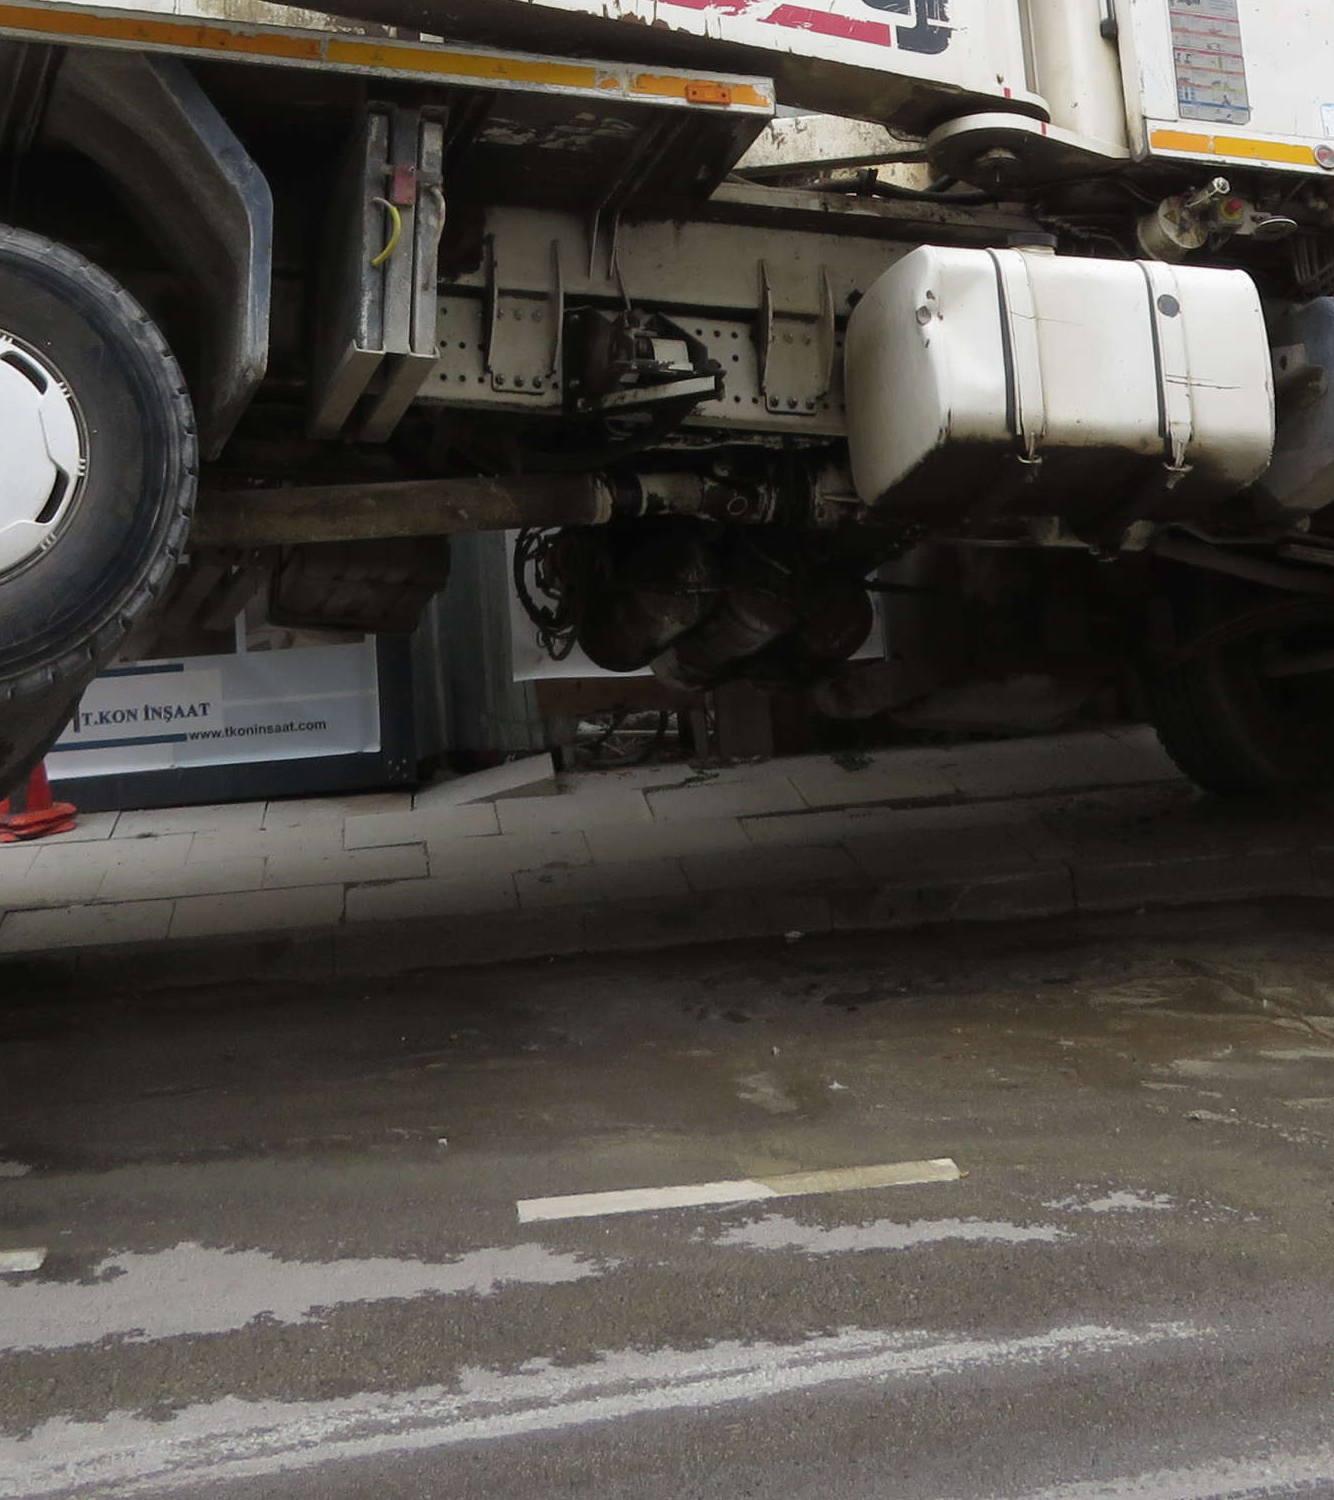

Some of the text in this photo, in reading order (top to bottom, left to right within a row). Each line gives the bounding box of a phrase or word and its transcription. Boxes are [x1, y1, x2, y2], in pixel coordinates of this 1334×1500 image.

[81, 702, 211, 727] T.KON İNŞAAT
[188, 719, 327, 742] www.tkoninsaat.com
